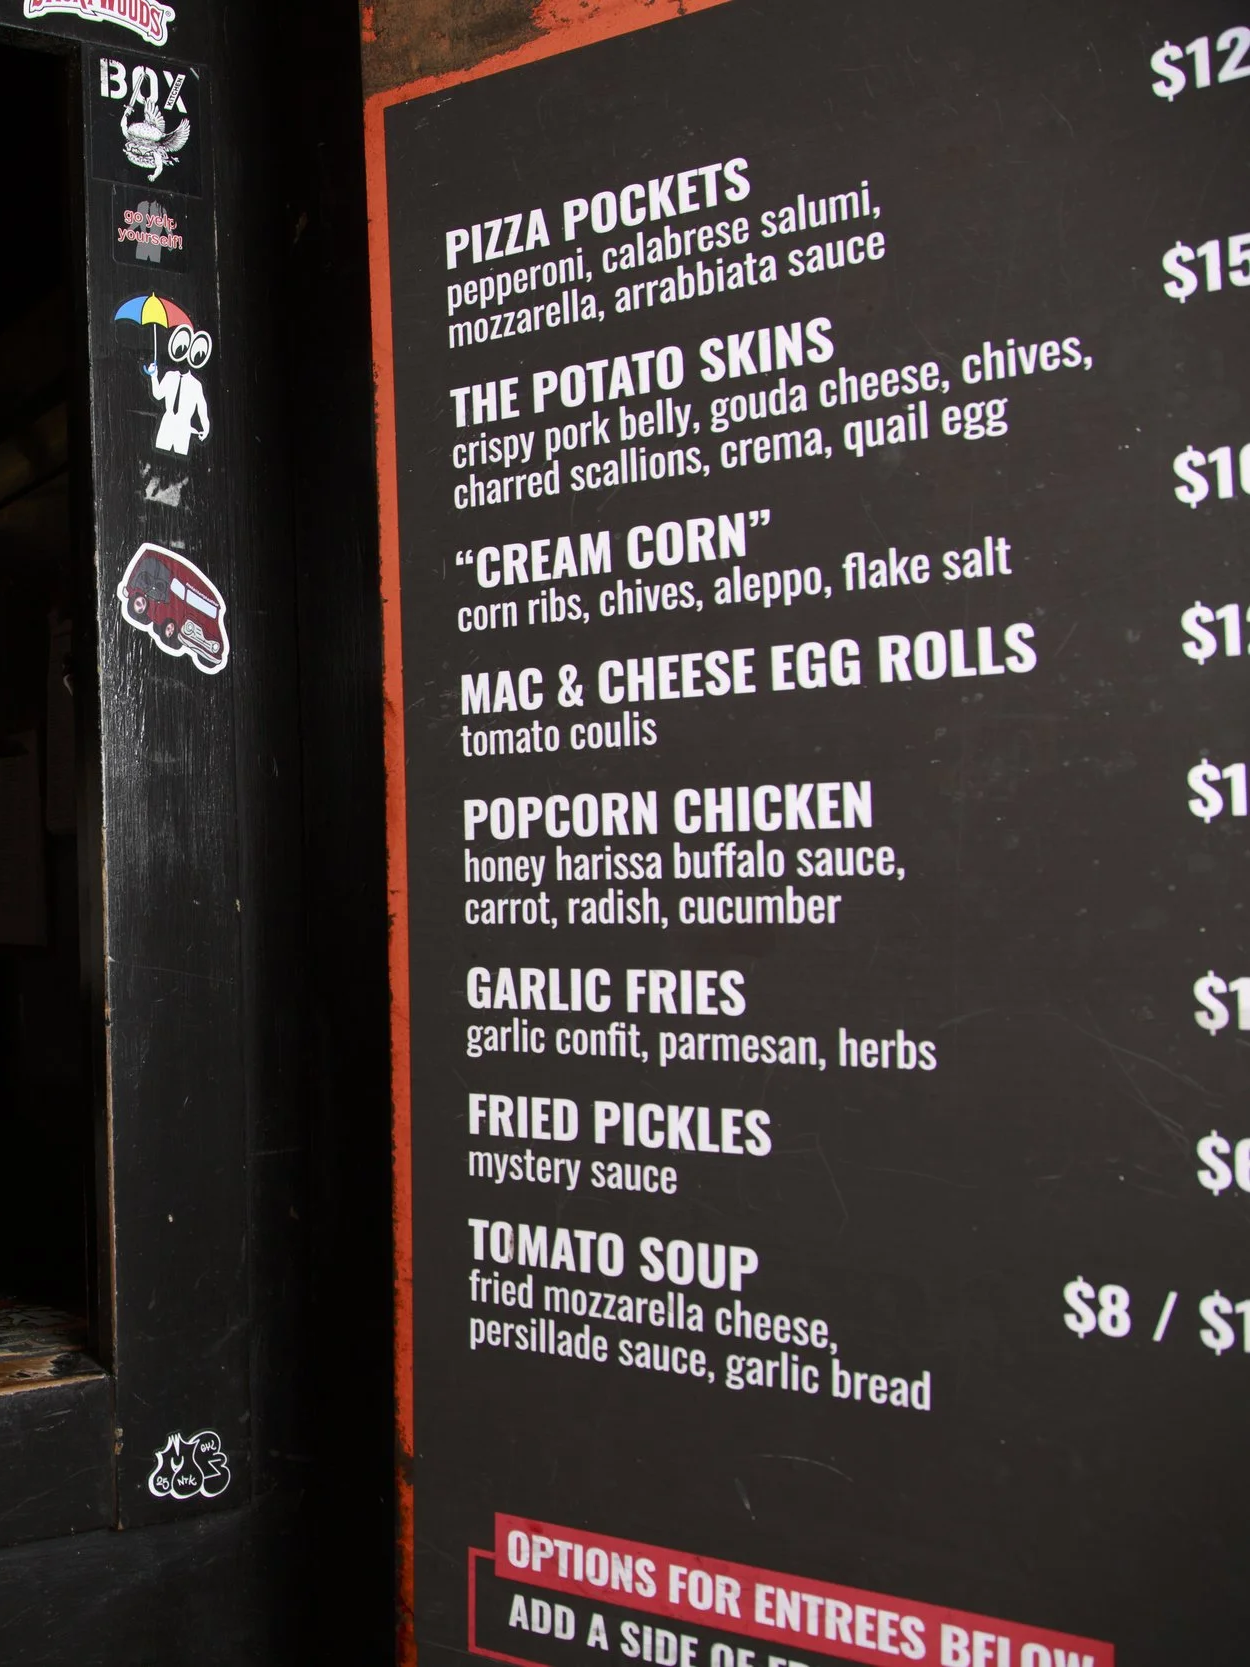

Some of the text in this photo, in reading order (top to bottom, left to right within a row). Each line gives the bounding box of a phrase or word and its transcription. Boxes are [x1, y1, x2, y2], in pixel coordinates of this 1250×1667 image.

[99, 57, 188, 114] BOX
[166, 77, 184, 108] KITCHEN
[118, 227, 182, 250] yourself!
[124, 210, 177, 231] go yelp
[445, 157, 751, 270] PIZZA POCKETS
[447, 180, 881, 317] pepperoni, calabrese salumi,
[1162, 232, 1250, 304] $15
[448, 231, 886, 349] mozzarella, arrabbiata sauce
[449, 316, 835, 428] THE POTATO SKINS
[452, 336, 1093, 469] crispy pork belly, gouda cheese, chives,
[453, 397, 1009, 510] charred scallions, crema, quail egg
[455, 508, 771, 589] “CREAM CORN”
[457, 535, 1013, 633] corn ribs, chives, aleppo, flake salt
[1180, 600, 1250, 666] $1
[460, 622, 1037, 716] MAC & CHEESE EGG ROLLS
[460, 710, 658, 757] tomato coulis
[463, 780, 873, 841] POPCORN CHICKEN
[1187, 757, 1248, 824] $1
[464, 839, 905, 888] honey harissa buffalo sauce,
[465, 885, 842, 930] carrot, radish, cucumber
[466, 966, 746, 1017] GARLIC FRIES
[466, 1017, 937, 1072] garlic confit, parmesan, herbs
[468, 1093, 772, 1157] FRIED PICKLES
[468, 1148, 677, 1195] mystery sauce
[468, 1218, 759, 1292] TOMATO SOUP
[468, 1268, 838, 1356] fried mozzarella cheese,
[1063, 1275, 1131, 1339] $8
[1153, 1291, 1178, 1342] /
[470, 1317, 931, 1411] persillade sauce, garlic bread
[507, 1530, 657, 1598] OPTIONS
[668, 1564, 741, 1619] FOR
[754, 1583, 926, 1660] ENTREES
[508, 1594, 575, 1641] ADD
[586, 1613, 609, 1651] A
[620, 1621, 699, 1667] SIDE
